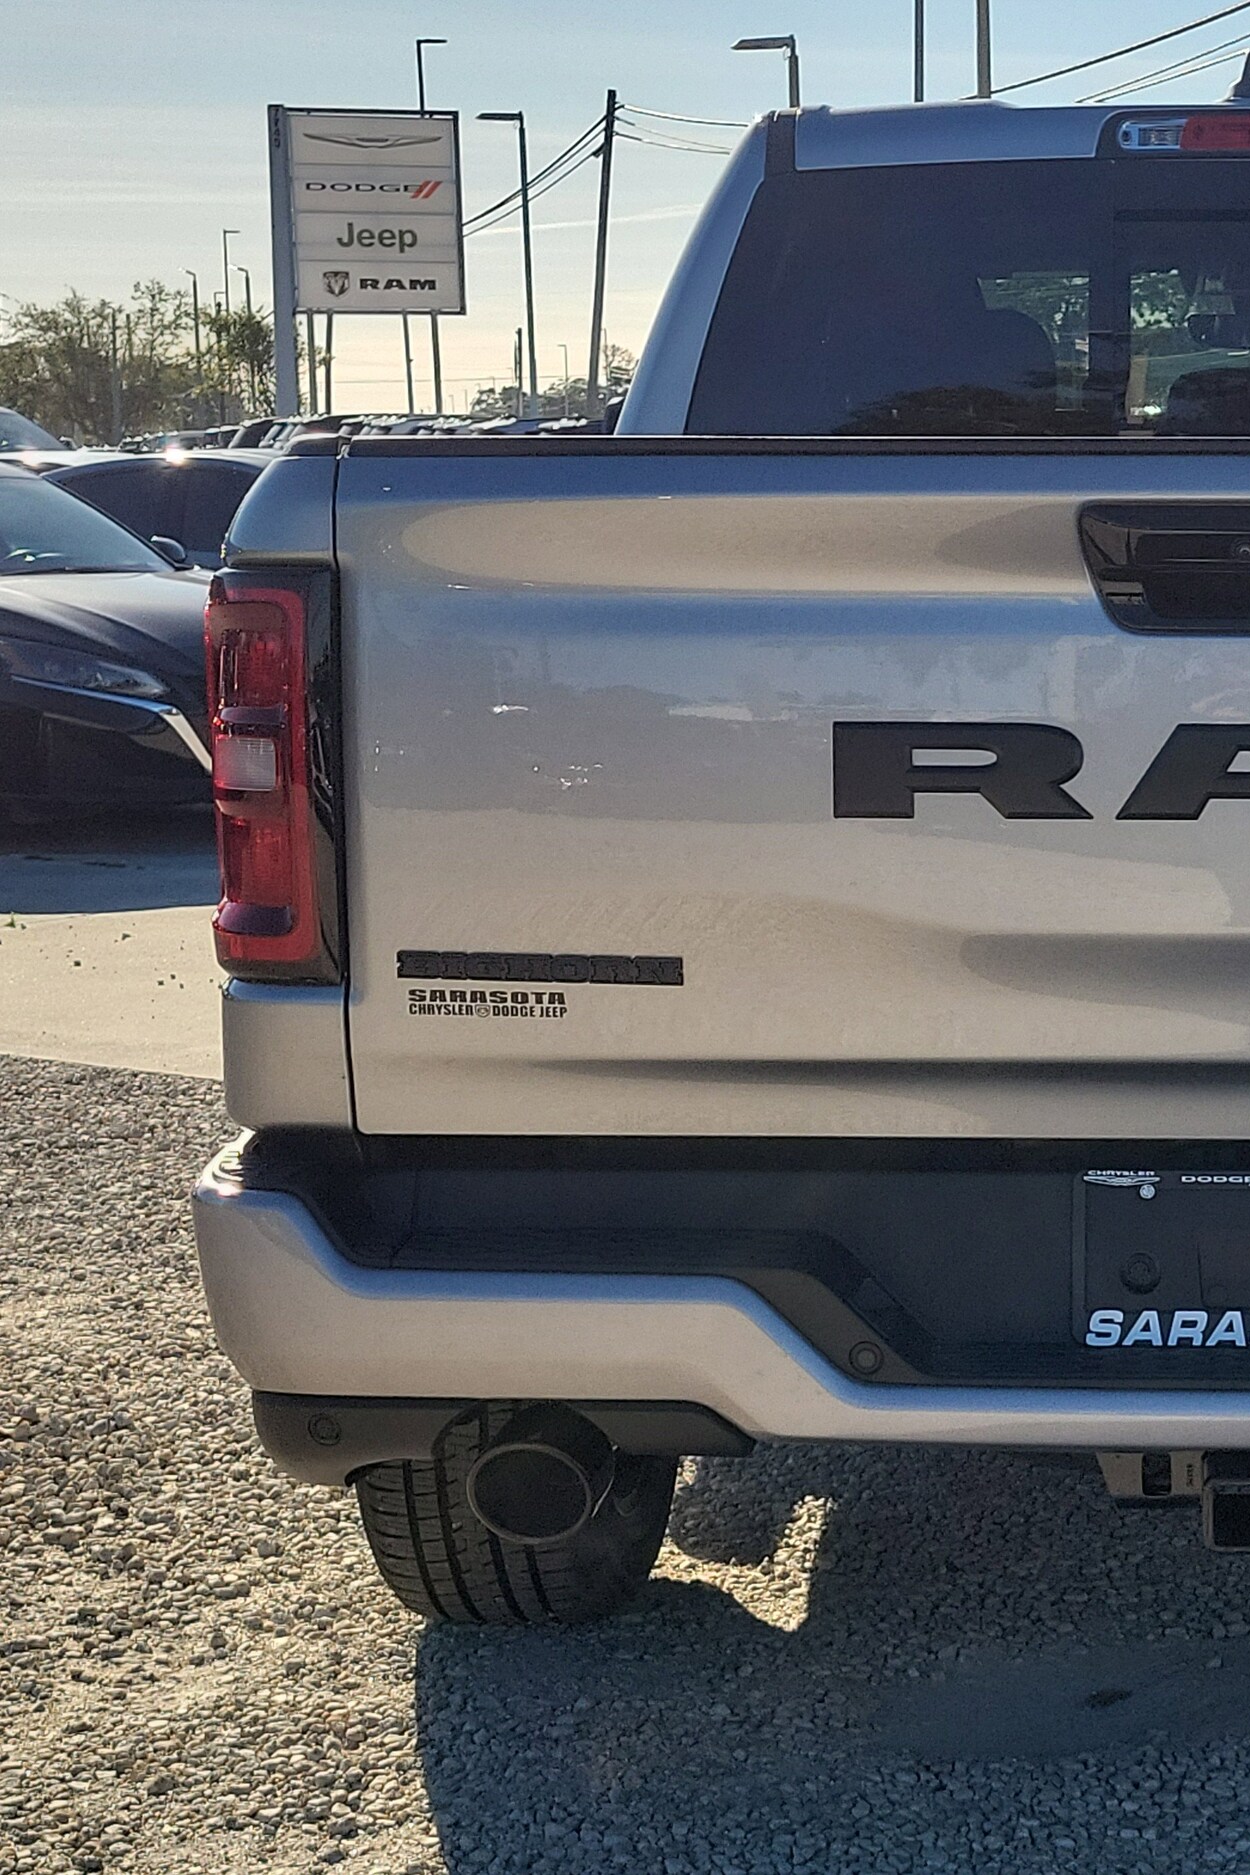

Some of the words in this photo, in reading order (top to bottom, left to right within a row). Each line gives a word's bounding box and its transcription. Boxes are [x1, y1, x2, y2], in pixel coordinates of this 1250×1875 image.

[336, 222, 418, 253] Jeep
[359, 277, 437, 291] RAM
[407, 988, 567, 1005] SARASOTA
[408, 1002, 475, 1016] CHRYSLER
[491, 1004, 536, 1017] DODGE
[539, 1004, 568, 1018] JEEP
